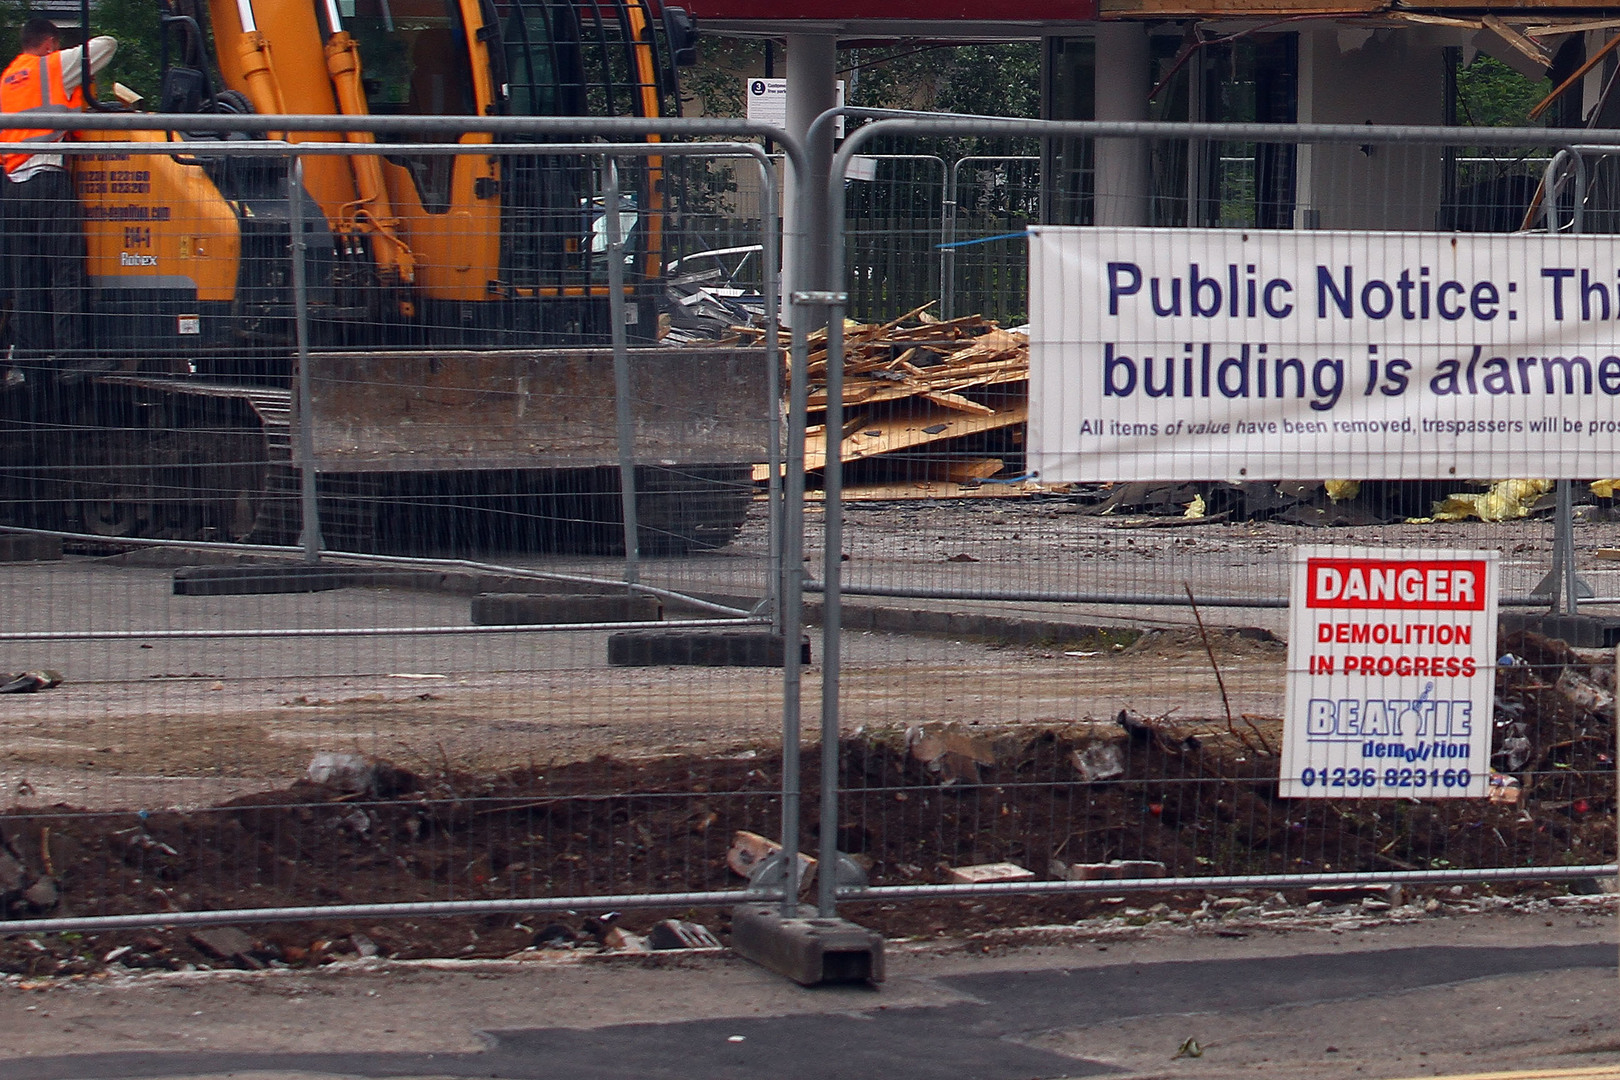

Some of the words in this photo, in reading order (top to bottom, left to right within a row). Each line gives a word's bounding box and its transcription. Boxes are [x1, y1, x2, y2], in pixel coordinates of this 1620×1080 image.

[121, 252, 158, 266] Robex
[1107, 262, 1294, 318] Public
[1316, 265, 1518, 321] Notice:
[1103, 342, 1345, 411] building
[1363, 344, 1413, 396] is
[1080, 419, 1104, 435] All
[1110, 419, 1159, 436] items
[1164, 419, 1185, 435] of
[1187, 420, 1231, 435] value
[1236, 419, 1277, 434] have
[1283, 418, 1328, 434] been
[1334, 417, 1417, 435] removed,
[1423, 418, 1524, 436] trespassers
[1529, 417, 1558, 432] will
[1563, 417, 1584, 433] be
[1315, 567, 1477, 603] DANGER
[1318, 622, 1472, 645] DEMOLITION
[1309, 655, 1335, 676] IN
[1344, 656, 1477, 678] PROGRESS
[1307, 698, 1473, 737] BEATTIE
[1362, 740, 1470, 763] demolition
[1301, 767, 1376, 787] 01236
[1384, 768, 1472, 788] 823160
